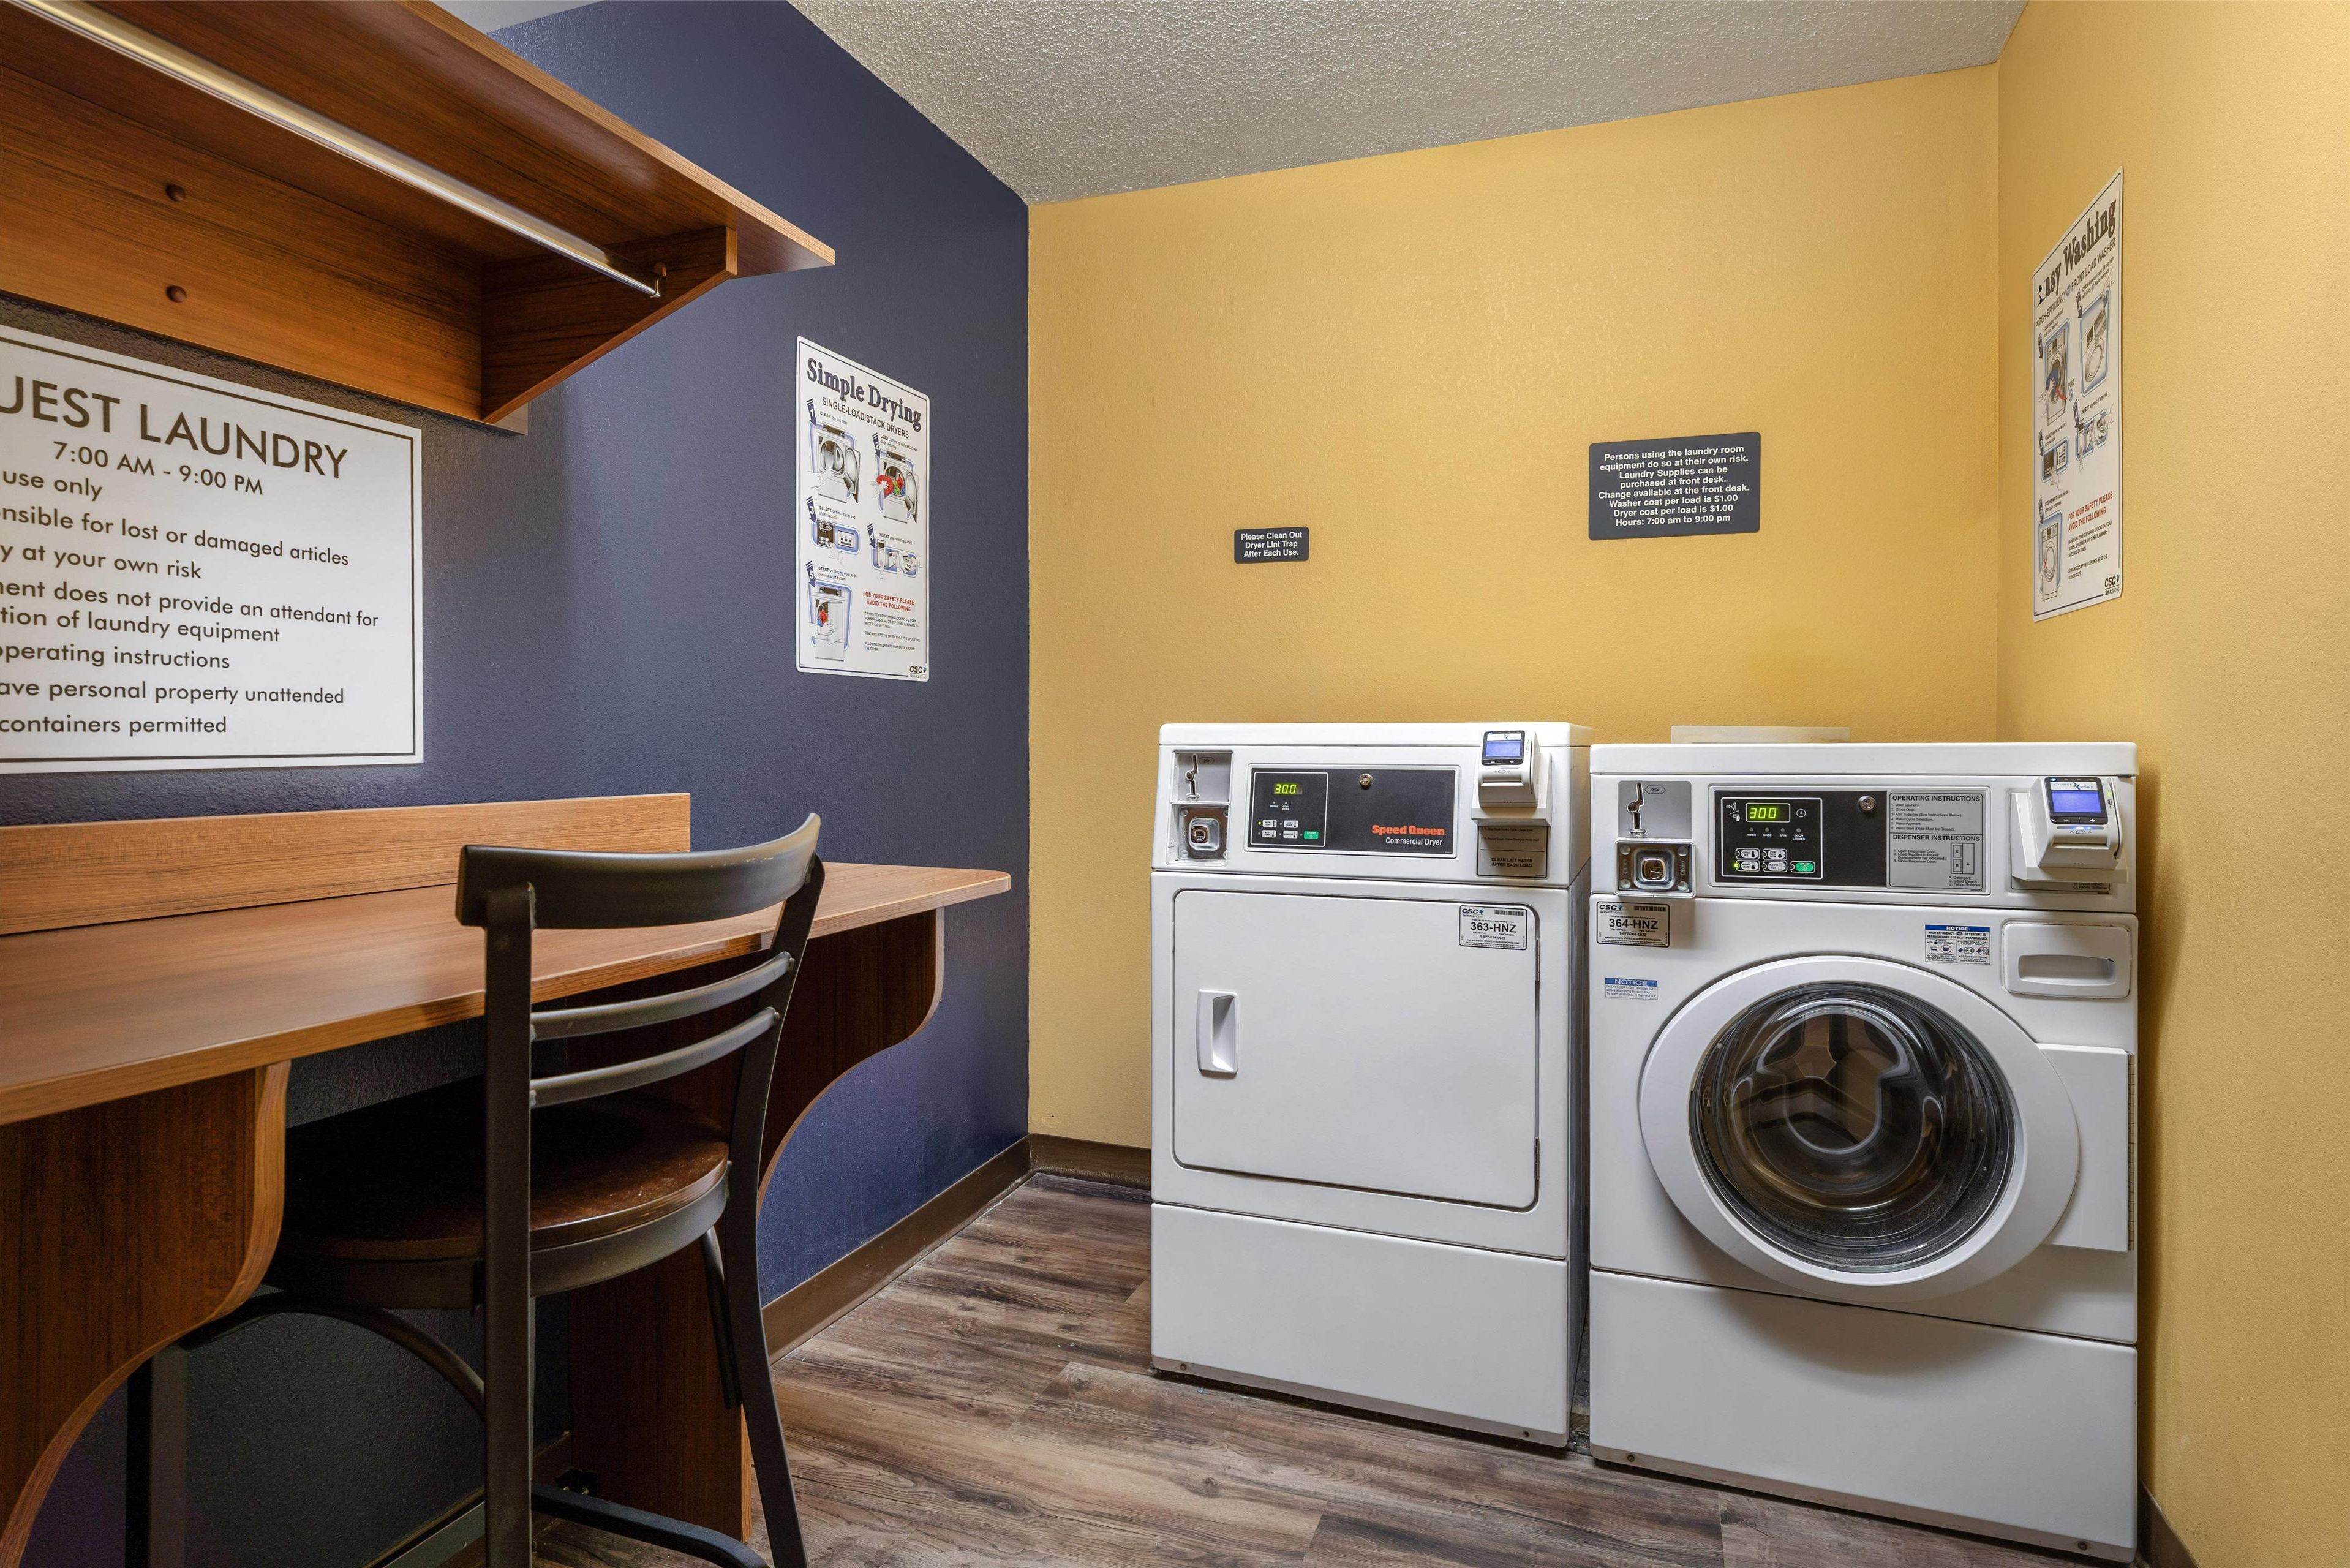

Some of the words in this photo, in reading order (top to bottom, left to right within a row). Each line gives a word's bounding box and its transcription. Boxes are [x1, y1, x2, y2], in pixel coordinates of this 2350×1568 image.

[2063, 199, 2116, 276] Washing
[2071, 270, 2084, 291] FRONT
[2085, 257, 2096, 276] LOAD
[2097, 237, 2115, 263] WASHER
[807, 358, 864, 402] Simple
[868, 384, 921, 432] Drying
[822, 396, 885, 429] SINGLE-LOAD/STACK
[886, 423, 908, 439] DRYERS
[140, 404, 347, 478] LAUNDRY
[1641, 450, 1665, 459] using
[53, 441, 108, 467] 7:00
[116, 454, 154, 476] AM
[179, 465, 226, 488] 9:00
[235, 475, 263, 495] PM
[1600, 461, 1644, 472] equipment
[1657, 468, 1695, 477] Supplies
[3, 471, 44, 488] use
[54, 478, 102, 501] only
[1620, 478, 1665, 489] purchased
[1633, 488, 1671, 497] available
[1714, 494, 1738, 502] $1.00
[2075, 506, 2084, 516] YOUR
[2085, 499, 2098, 512] SAFETY
[2098, 491, 2112, 505] PLEASE
[2068, 521, 2077, 530] AVOID
[2085, 506, 2106, 522] FOLLOWING
[2, 506, 73, 529] nsible
[81, 513, 113, 533] for
[122, 518, 158, 540] lost
[166, 531, 187, 543] or
[195, 530, 282, 557] damaged
[290, 546, 348, 565] articles
[23, 546, 45, 561] at
[54, 551, 105, 568] your
[114, 559, 157, 573] own
[167, 560, 201, 578] risk
[2104, 575, 2115, 587] CSC
[0, 582, 45, 597] ent
[54, 581, 107, 603] does
[118, 592, 151, 606] not
[160, 596, 233, 614] provide
[240, 605, 262, 616] an
[270, 605, 351, 624] attendant
[356, 610, 378, 626] for
[889, 603, 910, 611] FOLLOWING
[57, 610, 80, 628] of
[88, 611, 170, 638] laundry
[178, 622, 279, 643] equipment
[0, 643, 104, 666] perating
[114, 646, 229, 668] instructions
[50, 681, 145, 701] personal
[156, 686, 238, 704] property
[246, 687, 343, 703] unattended
[0, 715, 120, 732] containers
[130, 716, 225, 736] permitted
[1275, 784, 1297, 794] 300
[1750, 807, 1777, 819] 300
[1372, 824, 1407, 835] Speed
[1409, 825, 1445, 835] Queen
[1385, 837, 1423, 845] Commercial
[1425, 838, 1443, 846] Dryer
[1471, 922, 1516, 933] 363-HNZ
[1609, 918, 1658, 929] 364-HNZ
